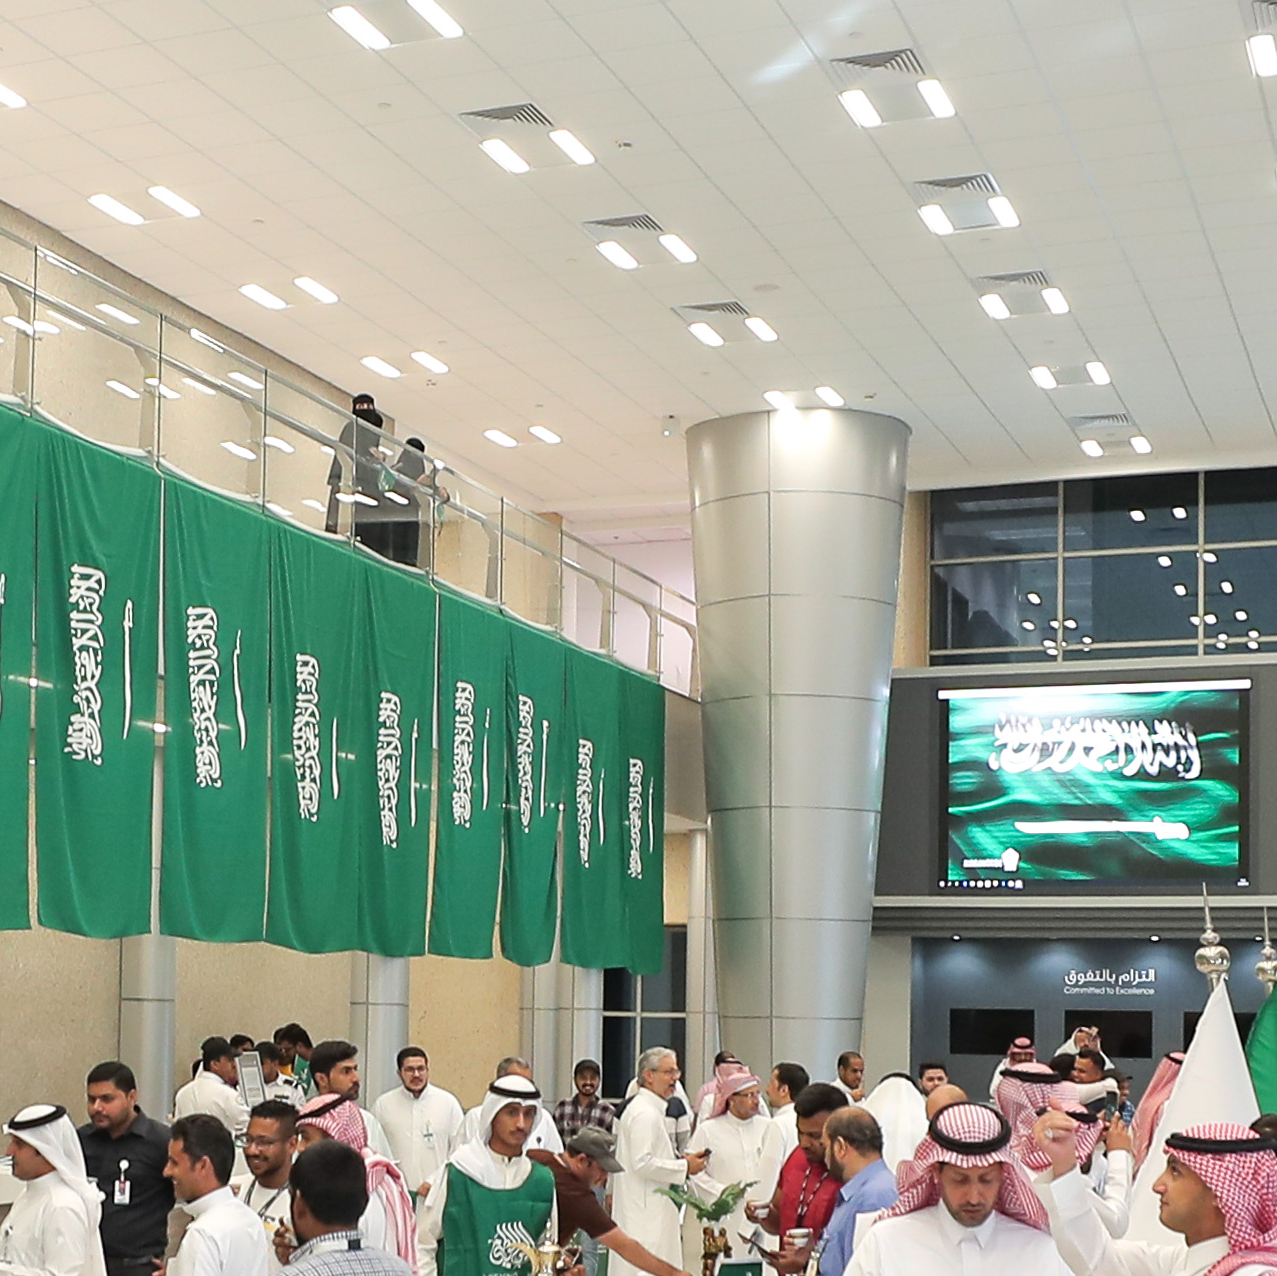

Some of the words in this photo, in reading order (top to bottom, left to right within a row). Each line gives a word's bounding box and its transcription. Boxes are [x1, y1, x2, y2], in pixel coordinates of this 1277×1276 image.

[1064, 969, 1116, 985] بالتفوق
[1118, 968, 1155, 985] التزام
[1064, 986, 1105, 995] Committed
[1106, 987, 1115, 995] to
[1116, 987, 1155, 995] Excellence
